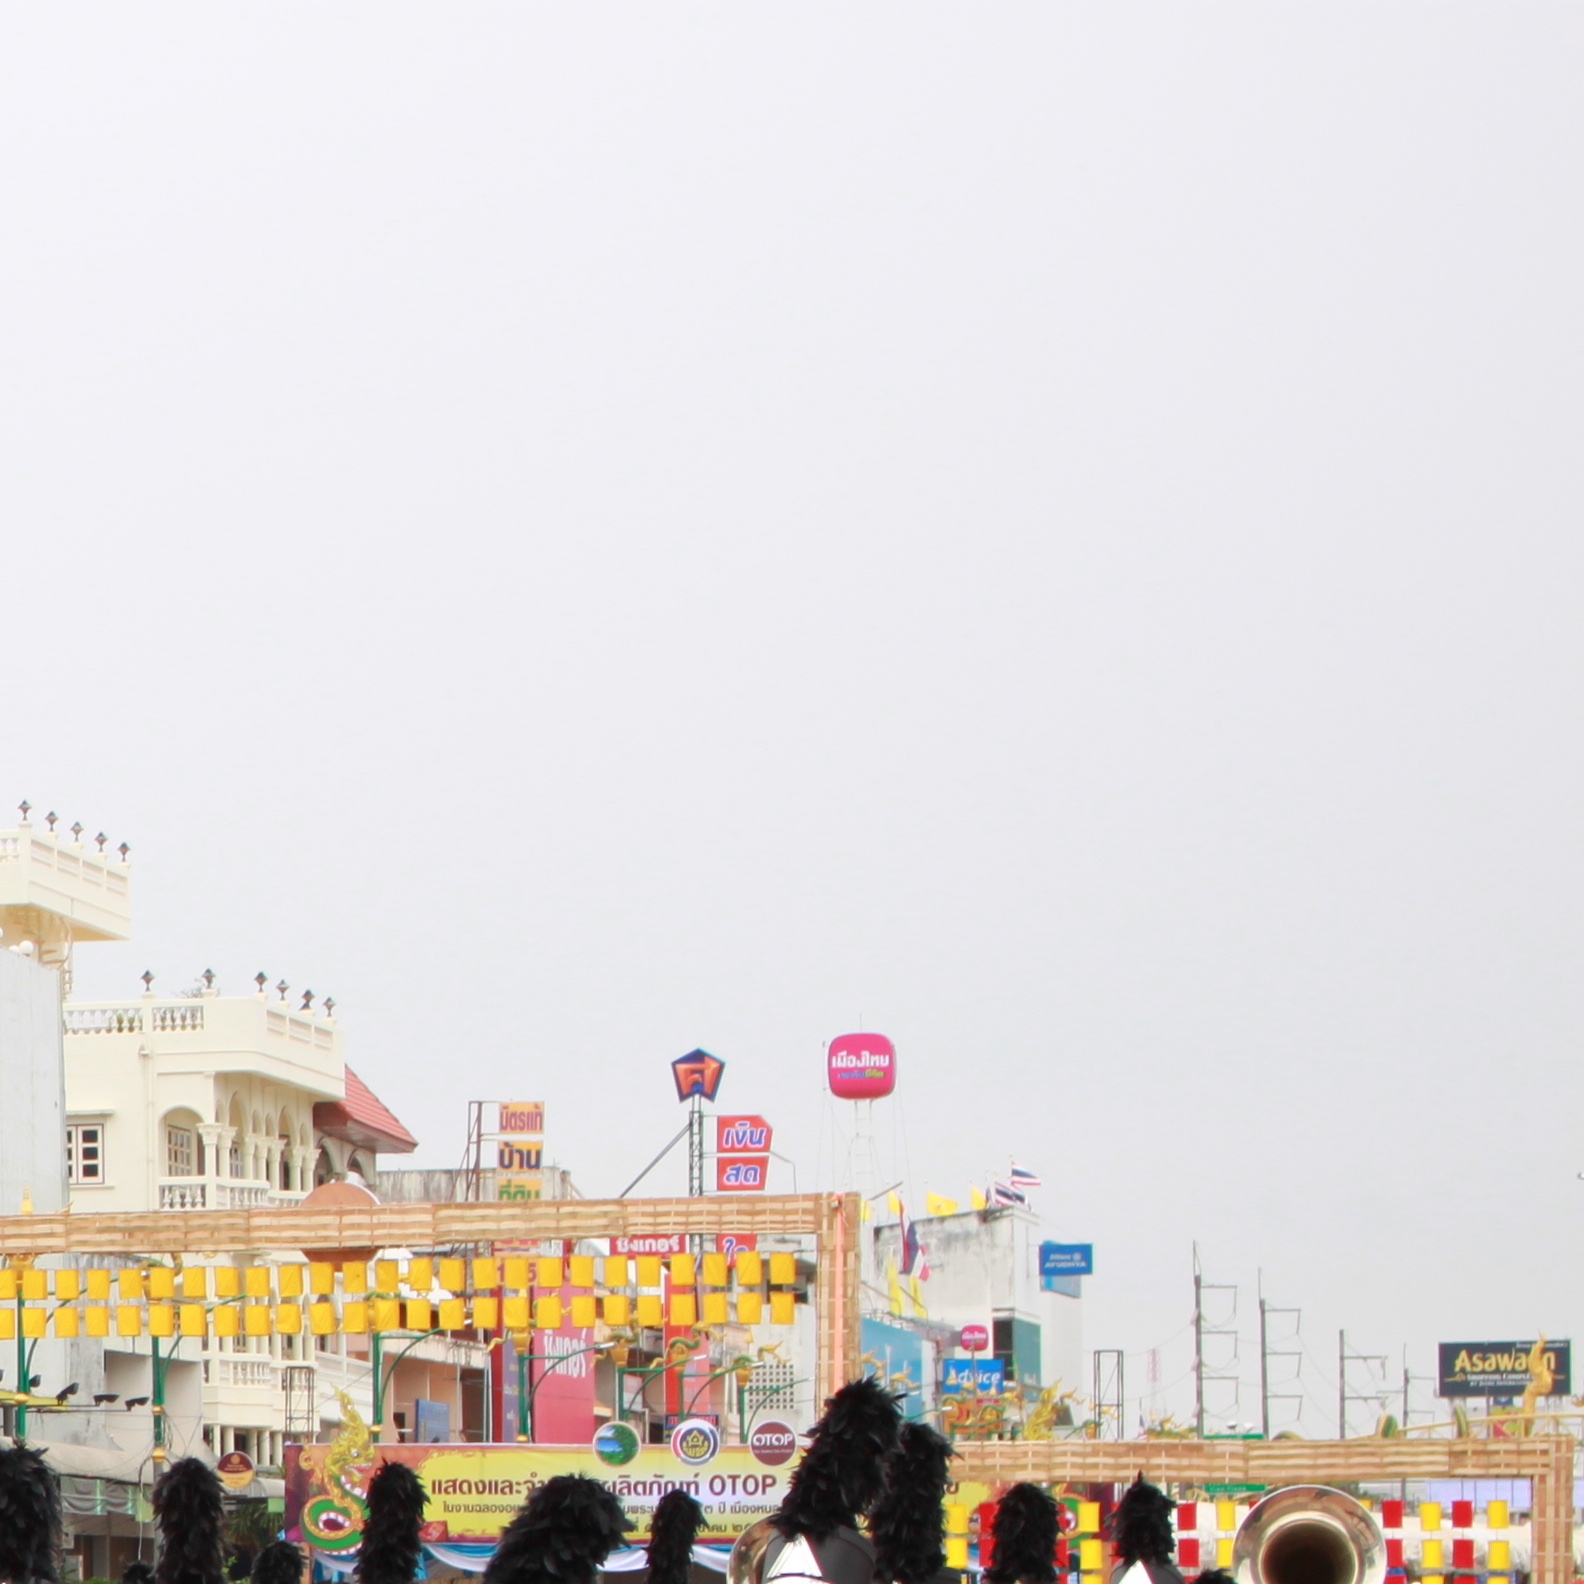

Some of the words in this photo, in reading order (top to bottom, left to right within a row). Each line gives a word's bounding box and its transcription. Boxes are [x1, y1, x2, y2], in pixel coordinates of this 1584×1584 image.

[724, 1121, 766, 1148] เงิน
[499, 1142, 542, 1171] บ้าน
[724, 1165, 759, 1184] สด
[1454, 1350, 1557, 1372] Asawan
[753, 1434, 793, 1446] OTOP
[709, 1475, 777, 1496] OTOP
